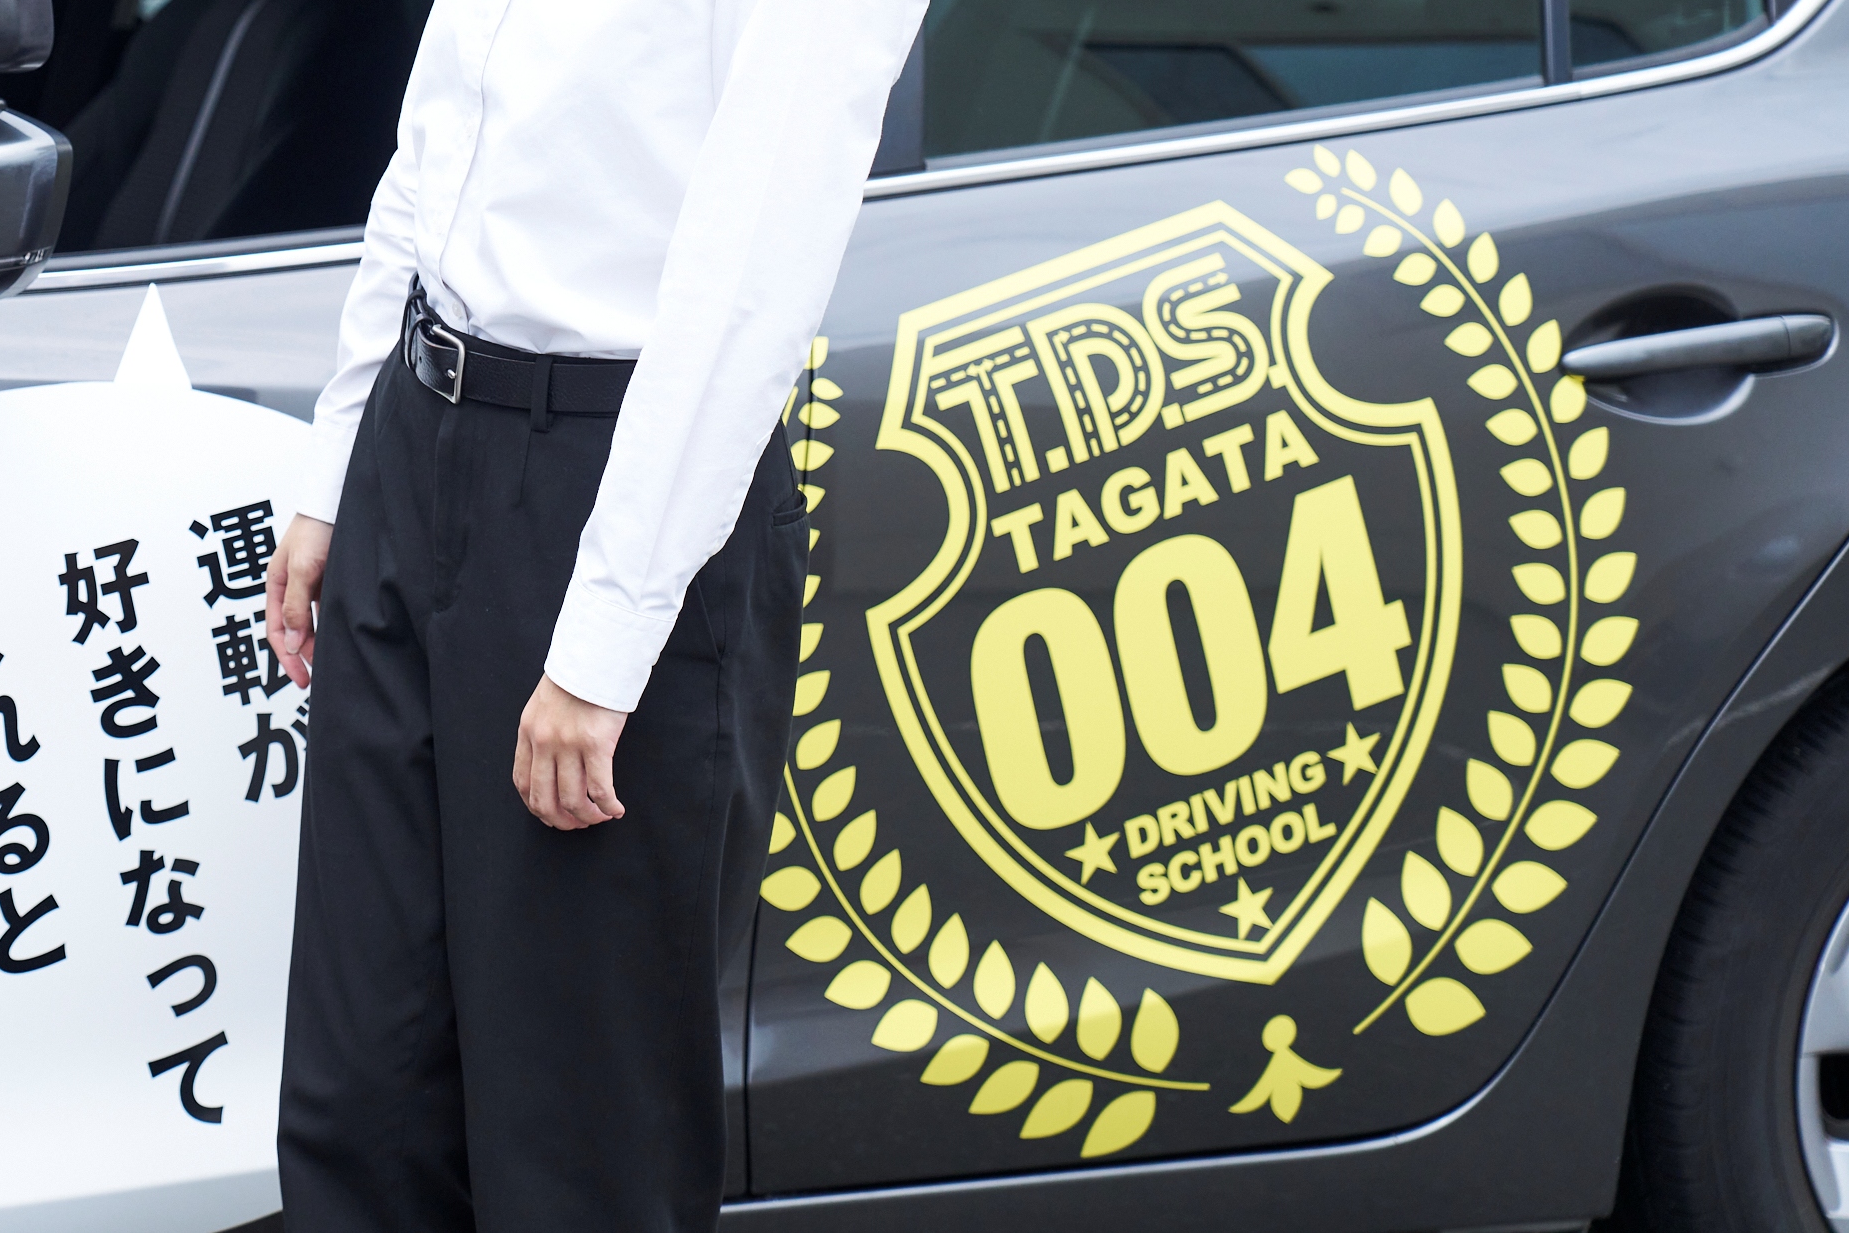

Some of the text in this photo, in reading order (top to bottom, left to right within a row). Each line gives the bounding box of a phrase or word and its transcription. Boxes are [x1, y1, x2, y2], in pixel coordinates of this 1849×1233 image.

[990, 410, 1320, 574] TAGATA
[189, 500, 311, 803] 運転が
[970, 475, 1412, 830] 004
[59, 539, 229, 1124] 好きになって
[1123, 750, 1327, 859] DRIVING
[1136, 802, 1338, 906] SCHOOL
